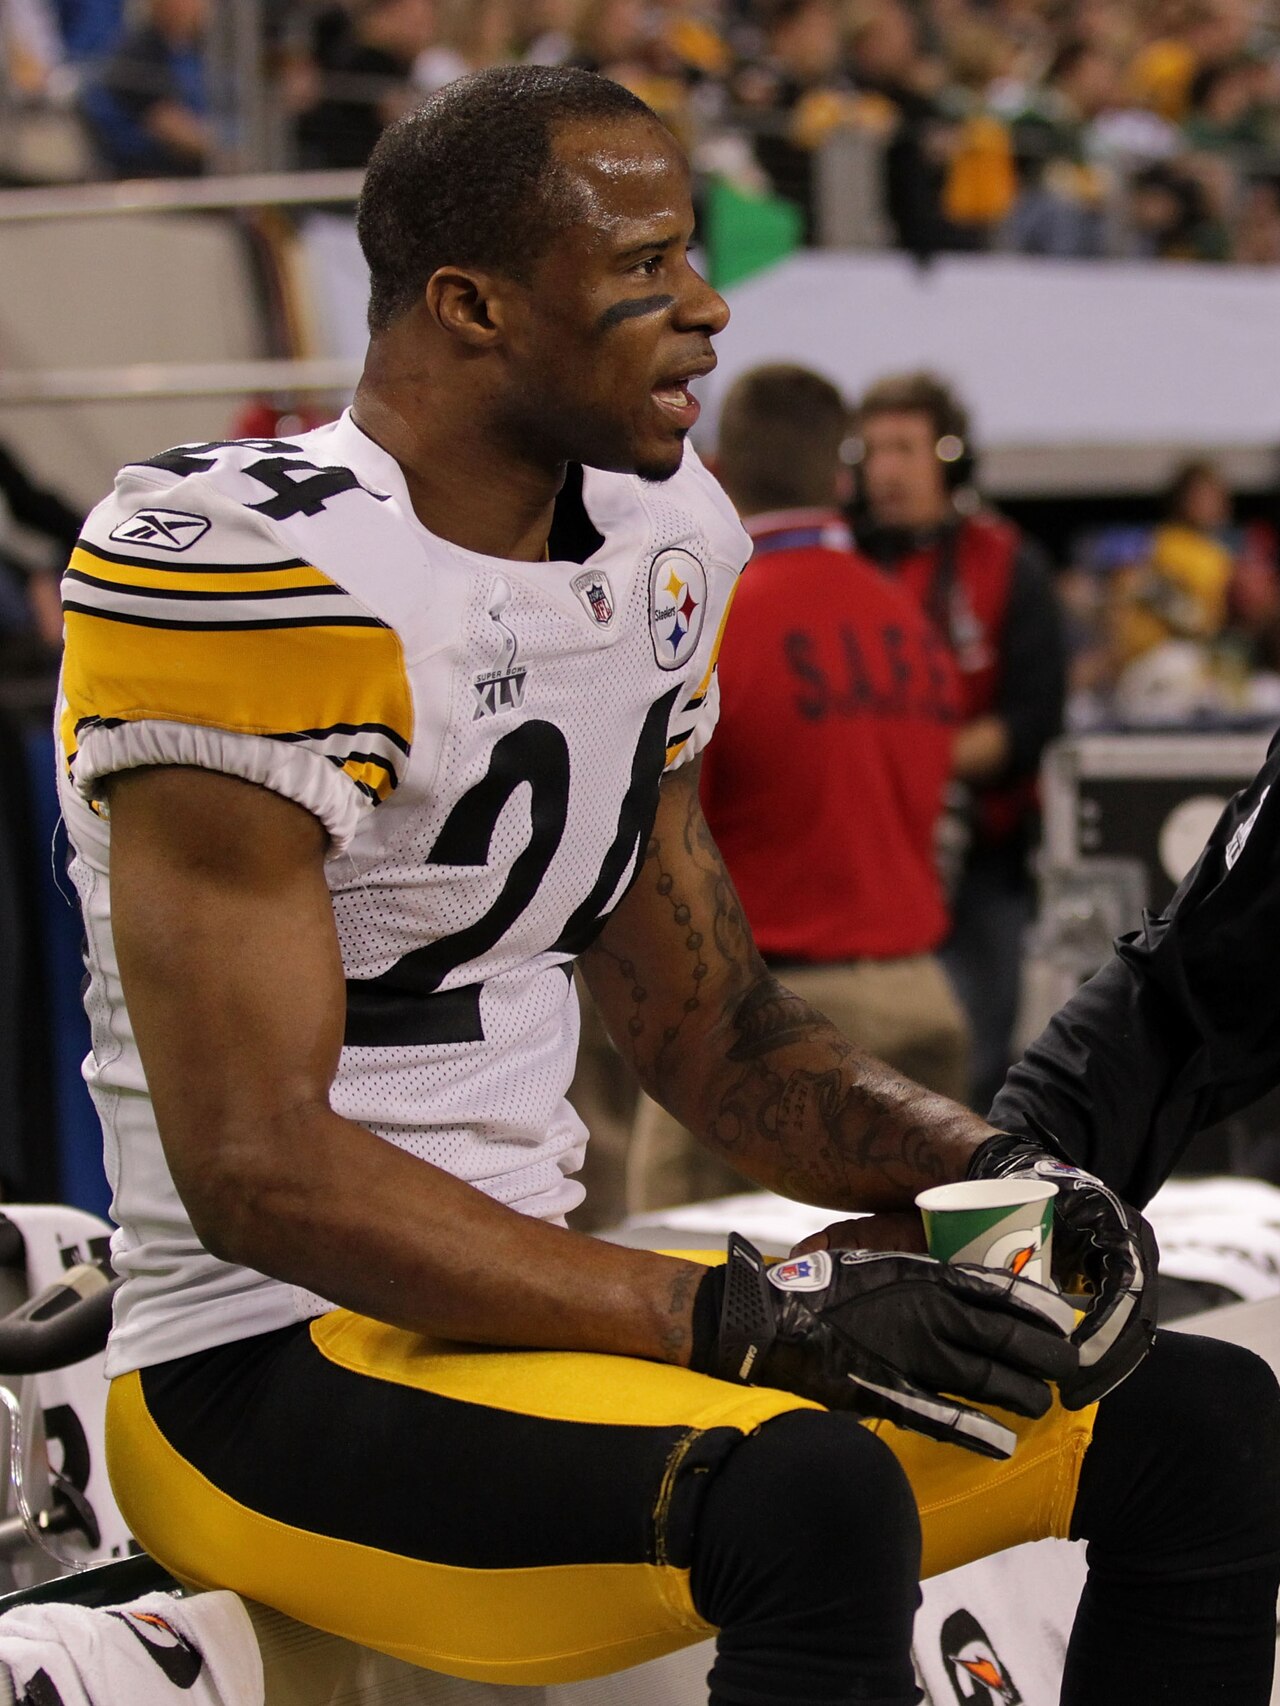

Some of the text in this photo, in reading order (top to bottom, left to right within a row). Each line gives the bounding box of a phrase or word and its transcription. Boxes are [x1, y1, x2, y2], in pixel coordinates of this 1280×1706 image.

[654, 605, 677, 622] Steelers
[476, 665, 527, 683] SUPER BOWL
[469, 672, 528, 722] XLV
